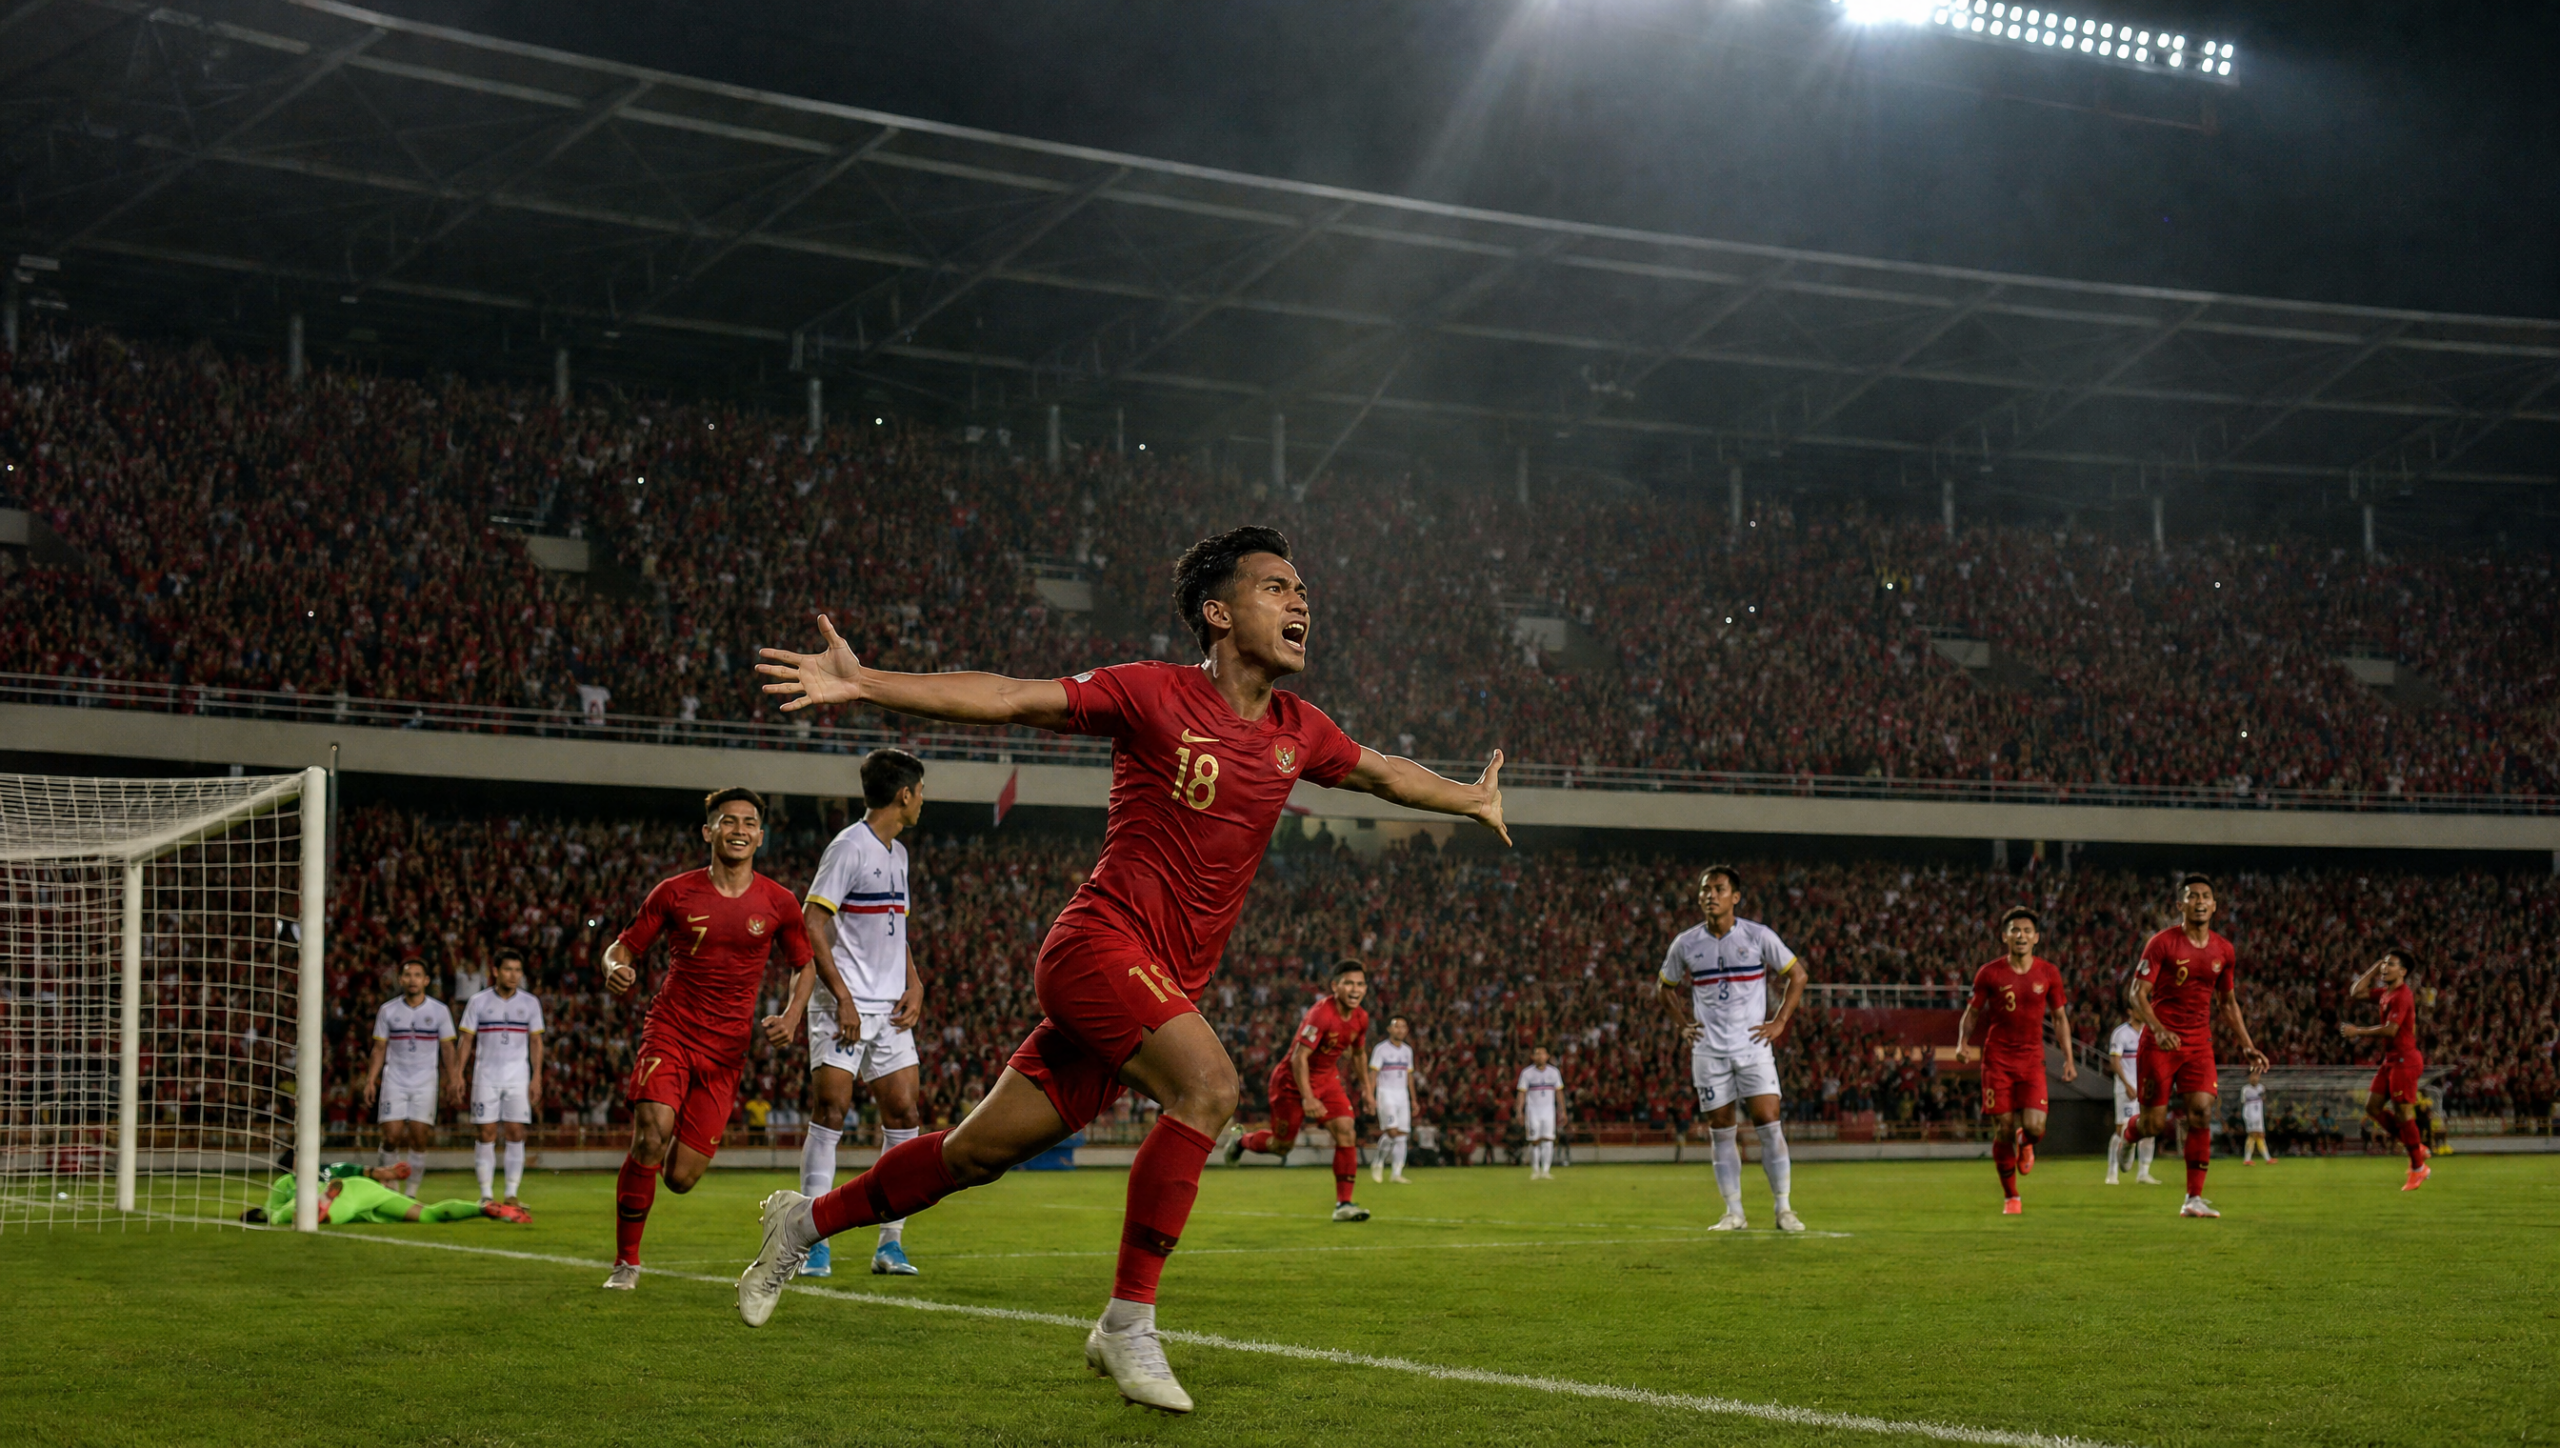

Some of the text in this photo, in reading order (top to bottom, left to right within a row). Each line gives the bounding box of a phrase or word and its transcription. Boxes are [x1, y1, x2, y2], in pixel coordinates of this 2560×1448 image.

[1171, 747, 1219, 810] 18
[691, 926, 708, 956] 7
[2175, 966, 2189, 987] 9
[2005, 991, 2016, 1012] 3
[638, 1056, 662, 1087] 17
